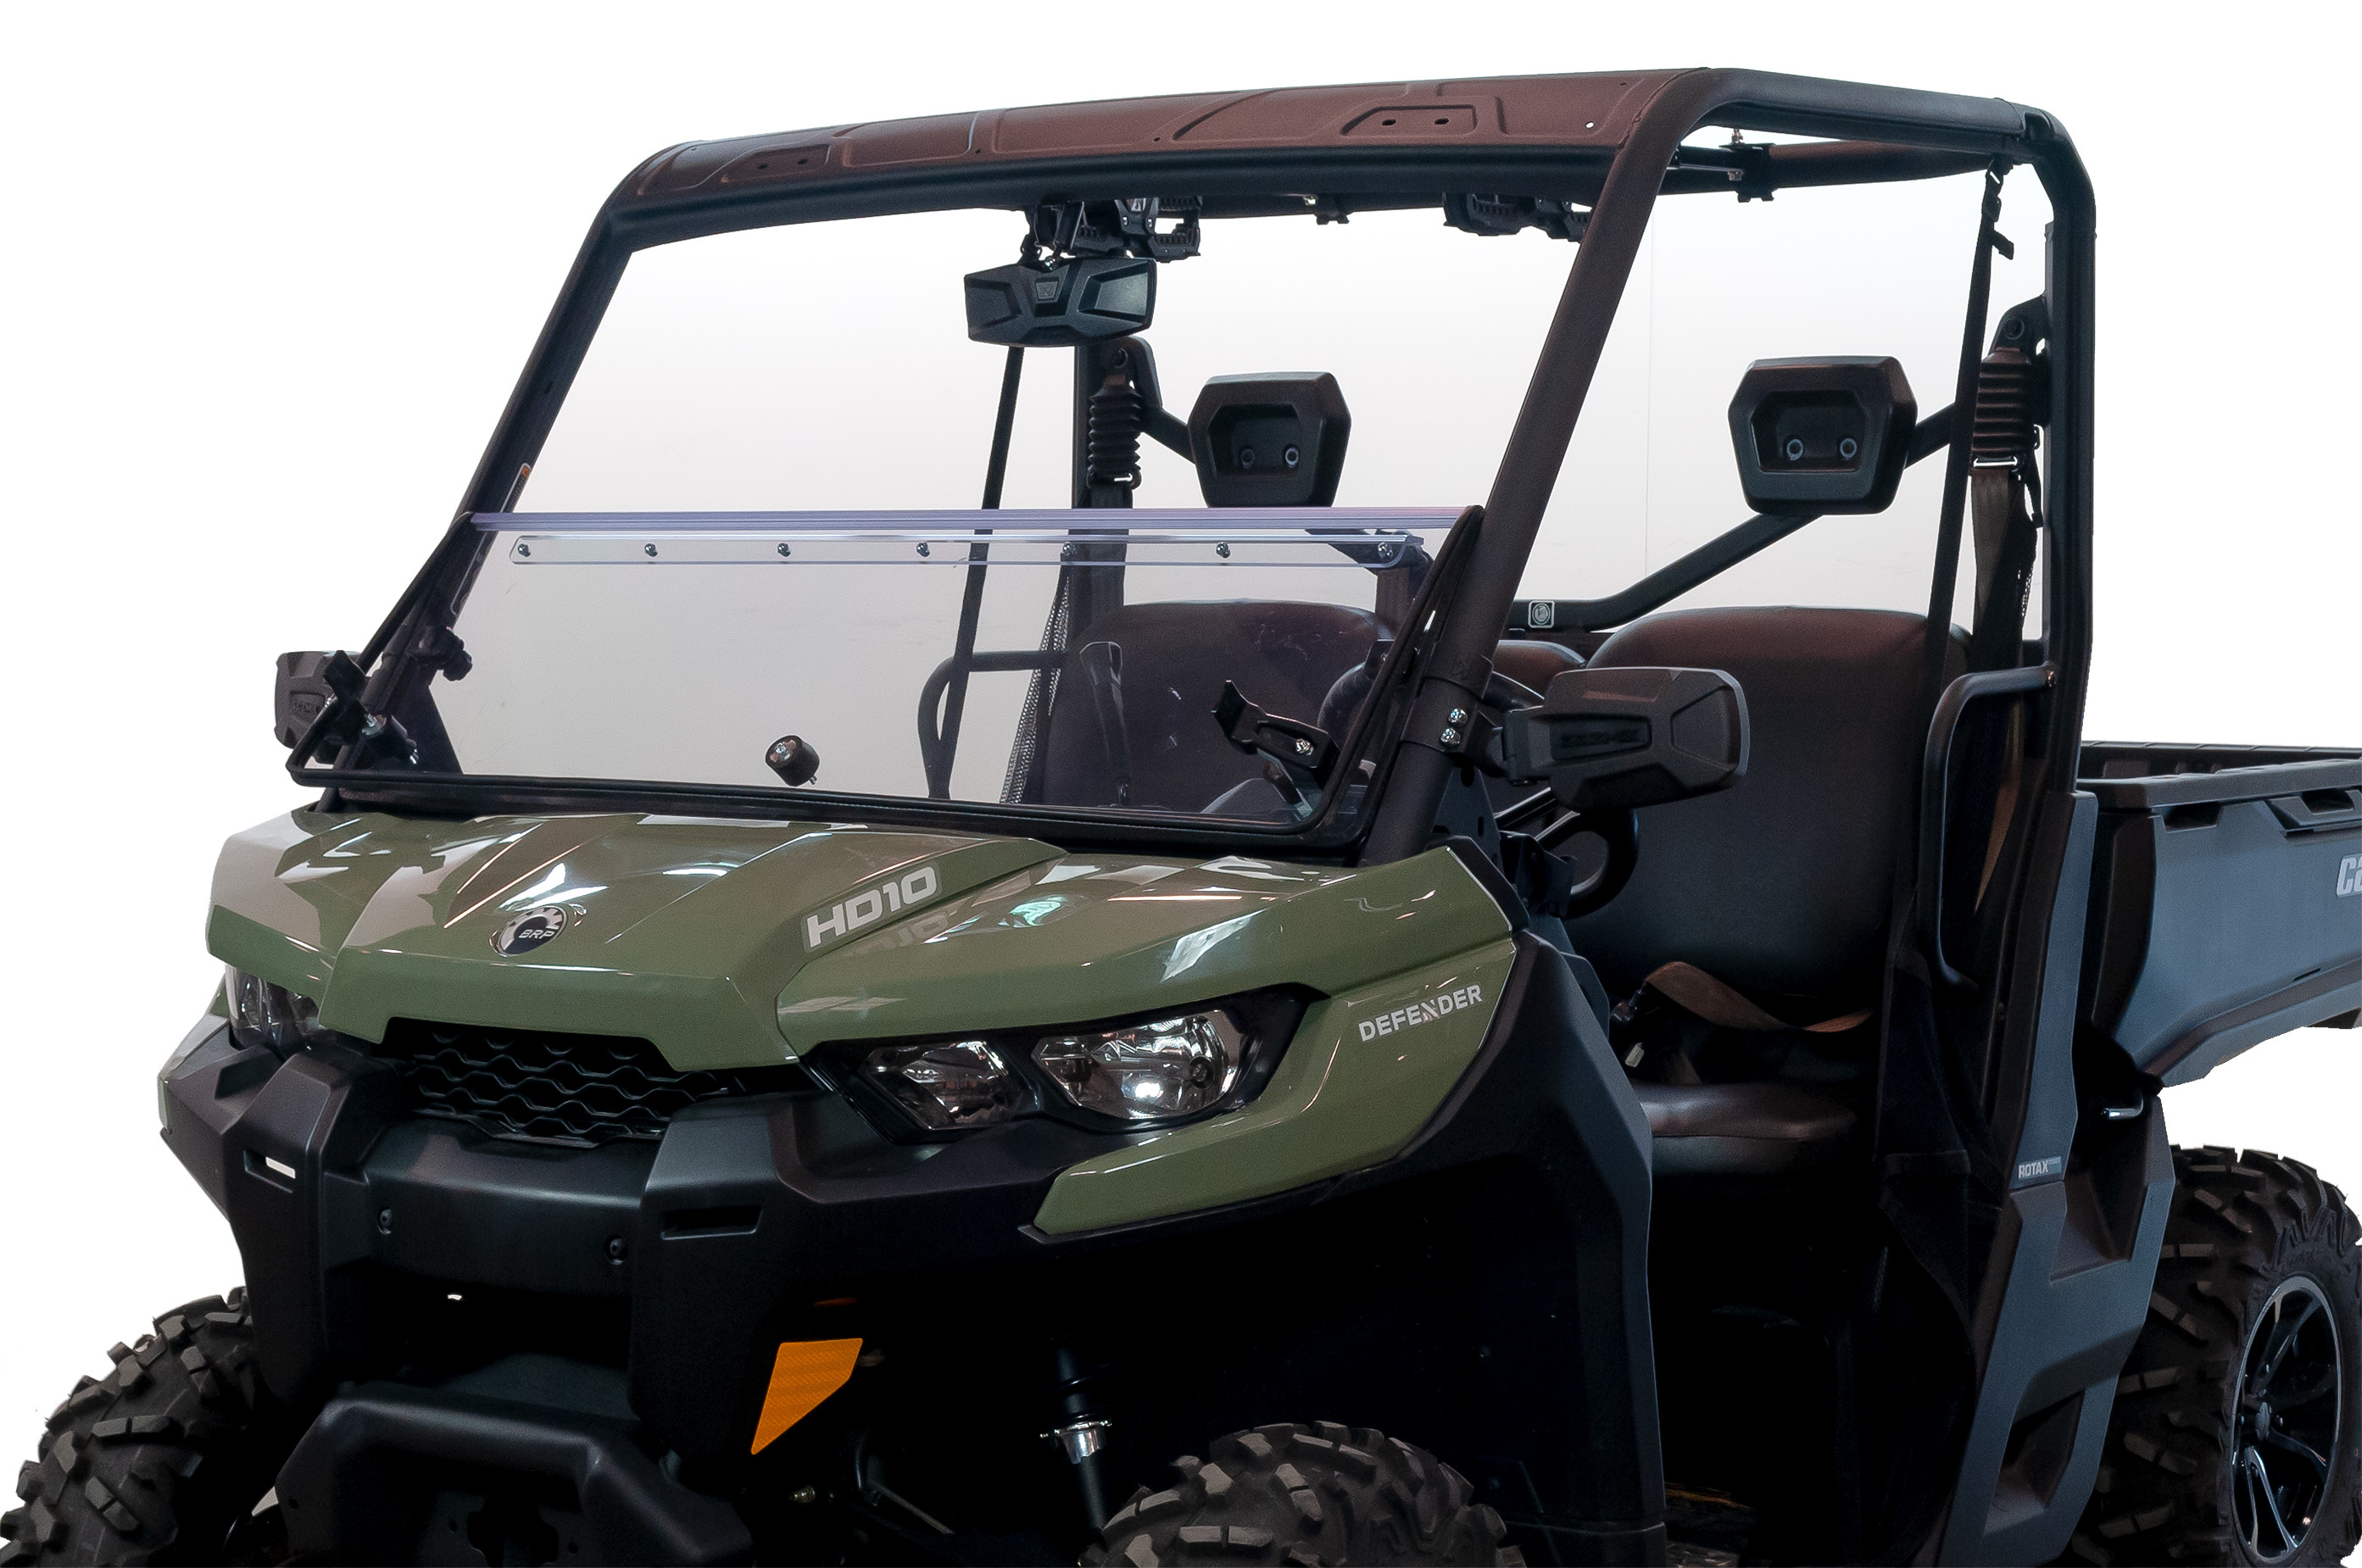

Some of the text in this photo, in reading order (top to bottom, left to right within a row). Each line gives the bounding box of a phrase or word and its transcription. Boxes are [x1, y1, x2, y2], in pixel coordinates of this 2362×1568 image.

[807, 866, 938, 948] HD10
[518, 929, 555, 939] BRP
[1358, 984, 1483, 1043] DEFENDER
[2018, 1160, 2048, 1179] ROTAX
